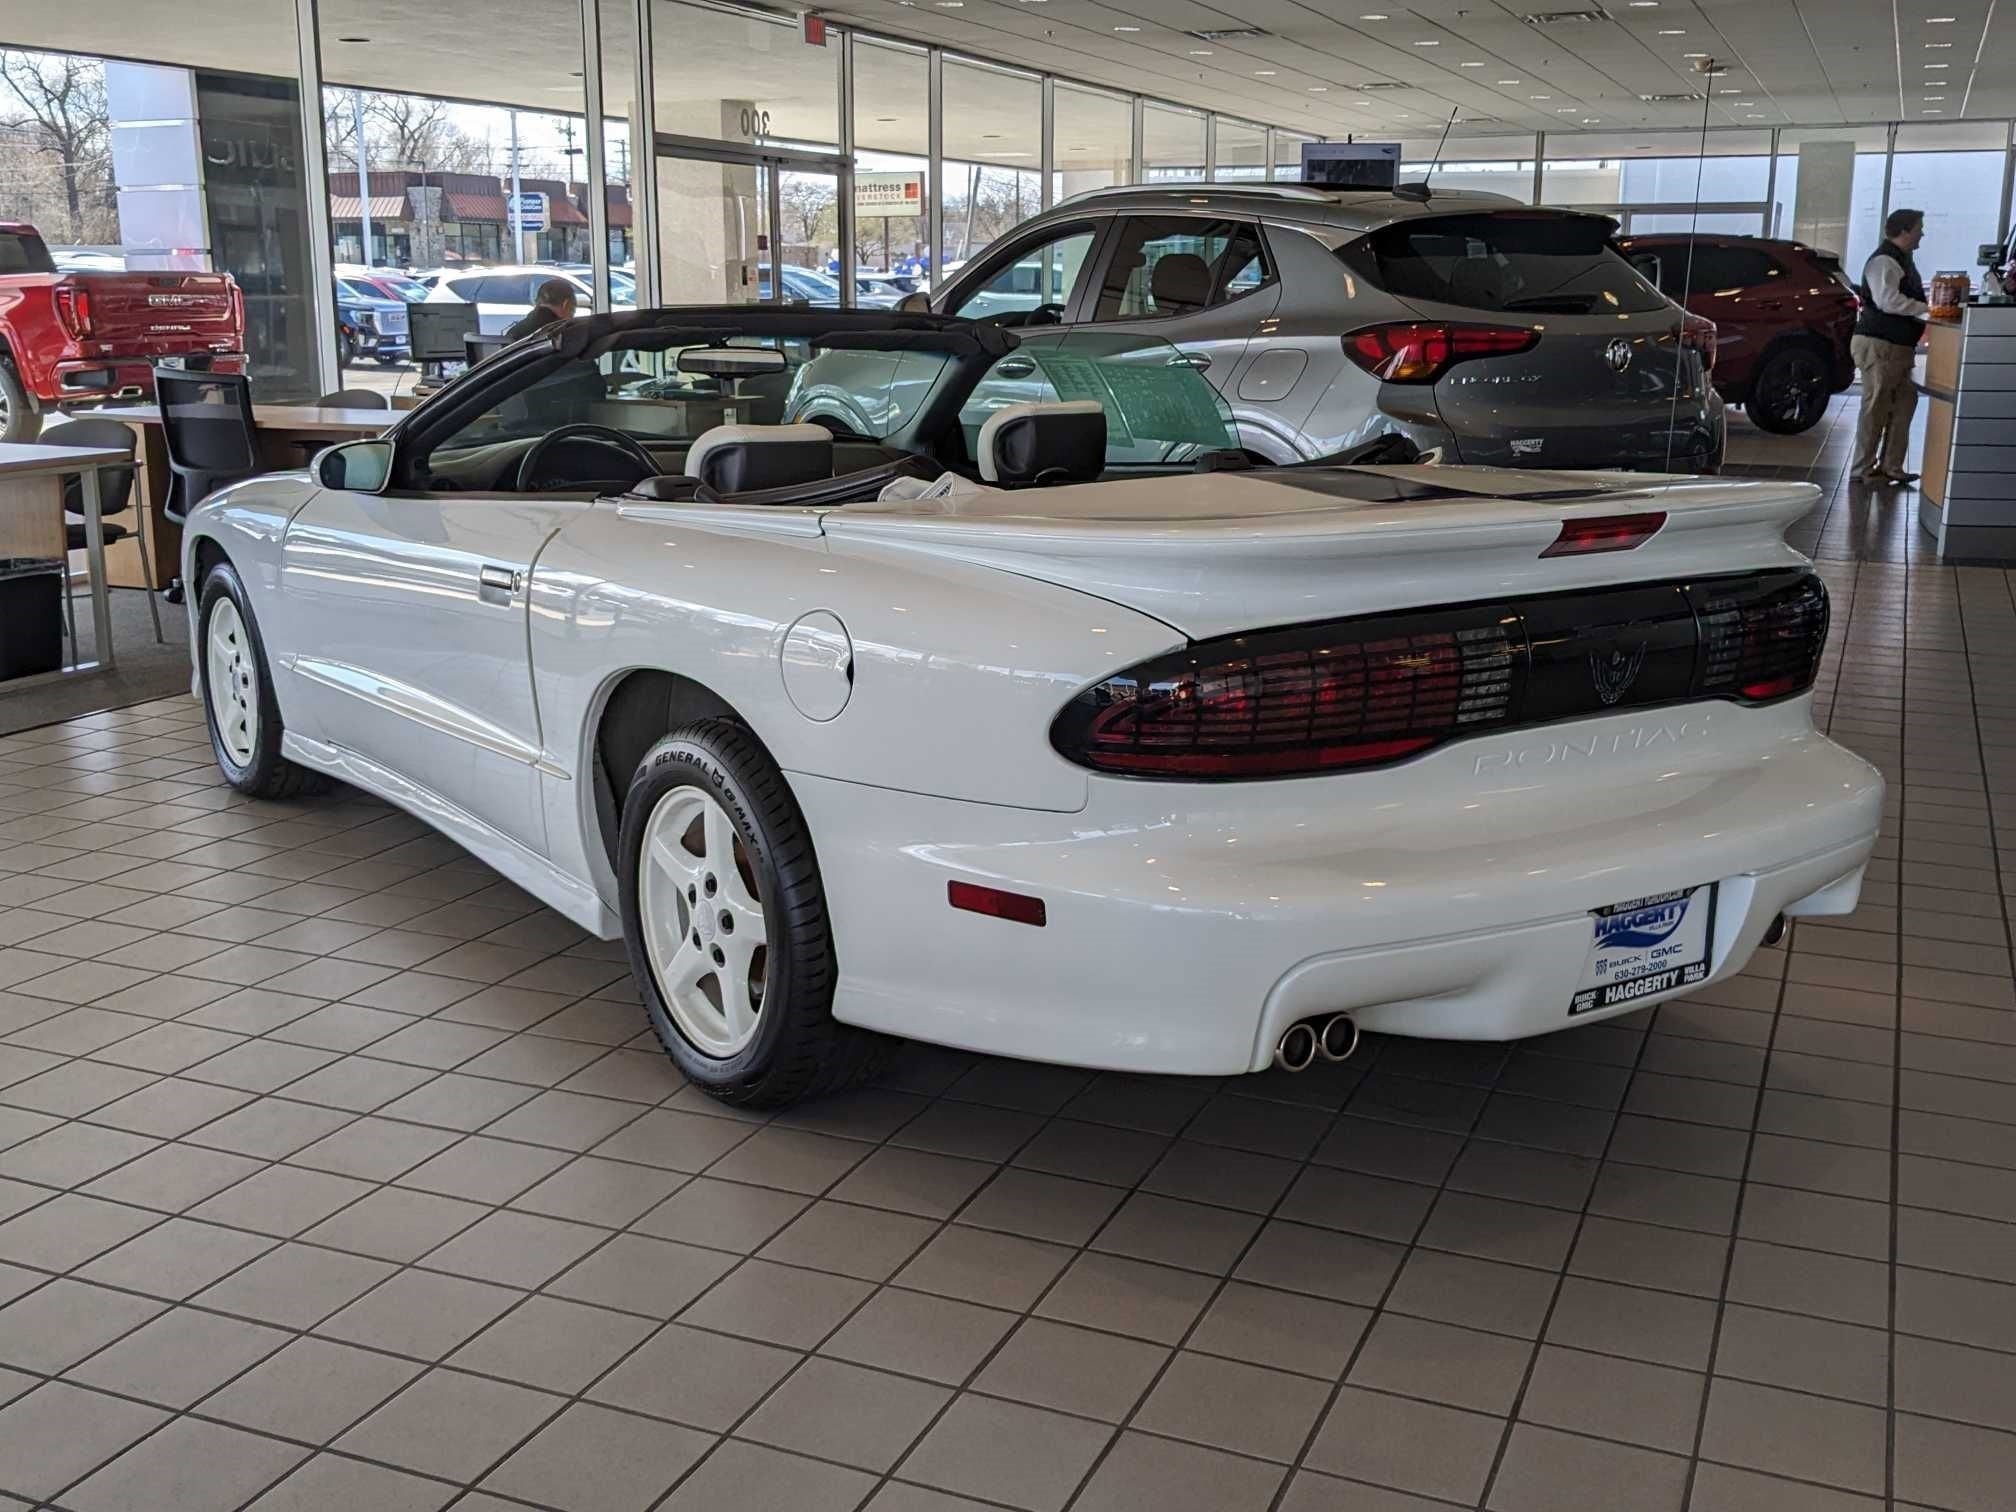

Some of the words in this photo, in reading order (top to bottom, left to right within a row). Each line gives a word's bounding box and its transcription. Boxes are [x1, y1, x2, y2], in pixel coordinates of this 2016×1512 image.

[1473, 714, 1713, 776] PONTIAC
[655, 750, 710, 776] GENERAL
[1594, 899, 1690, 938] HAGGERTY
[1609, 954, 1642, 968] BUICK
[1650, 943, 1683, 959] GMC
[1614, 959, 1668, 981] 630-279-2000
[1684, 963, 1705, 975] VILLA
[1574, 990, 1597, 1005] BUICK
[1605, 969, 1680, 1004] HAGGERTY
[1576, 1000, 1594, 1012] GMC
